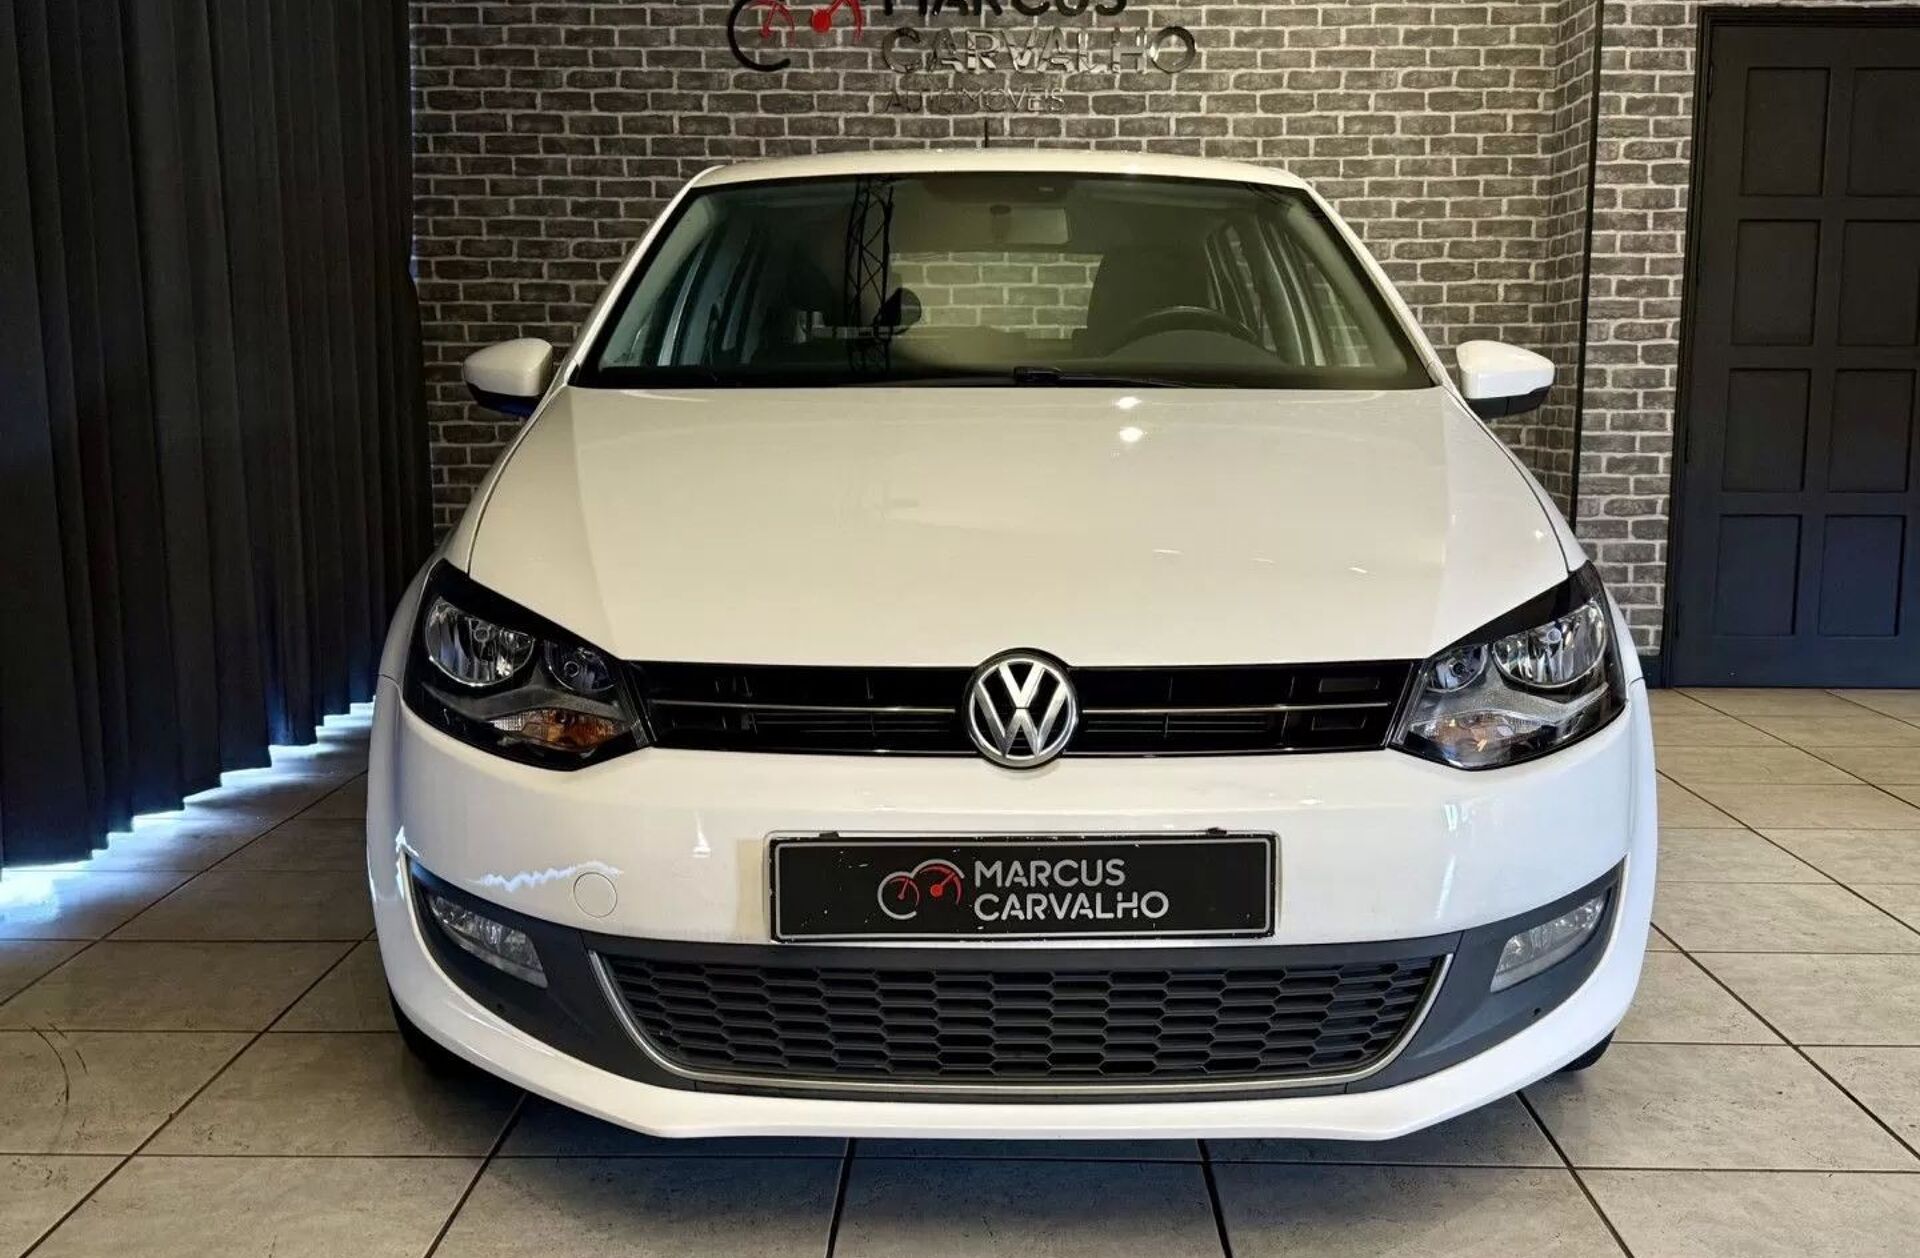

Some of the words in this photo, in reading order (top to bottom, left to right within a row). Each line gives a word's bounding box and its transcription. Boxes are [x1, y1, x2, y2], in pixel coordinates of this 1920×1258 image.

[882, 26, 1196, 74] CARVALHO
[974, 859, 1126, 888] MARCUS
[974, 890, 1170, 922] CARVALHO
